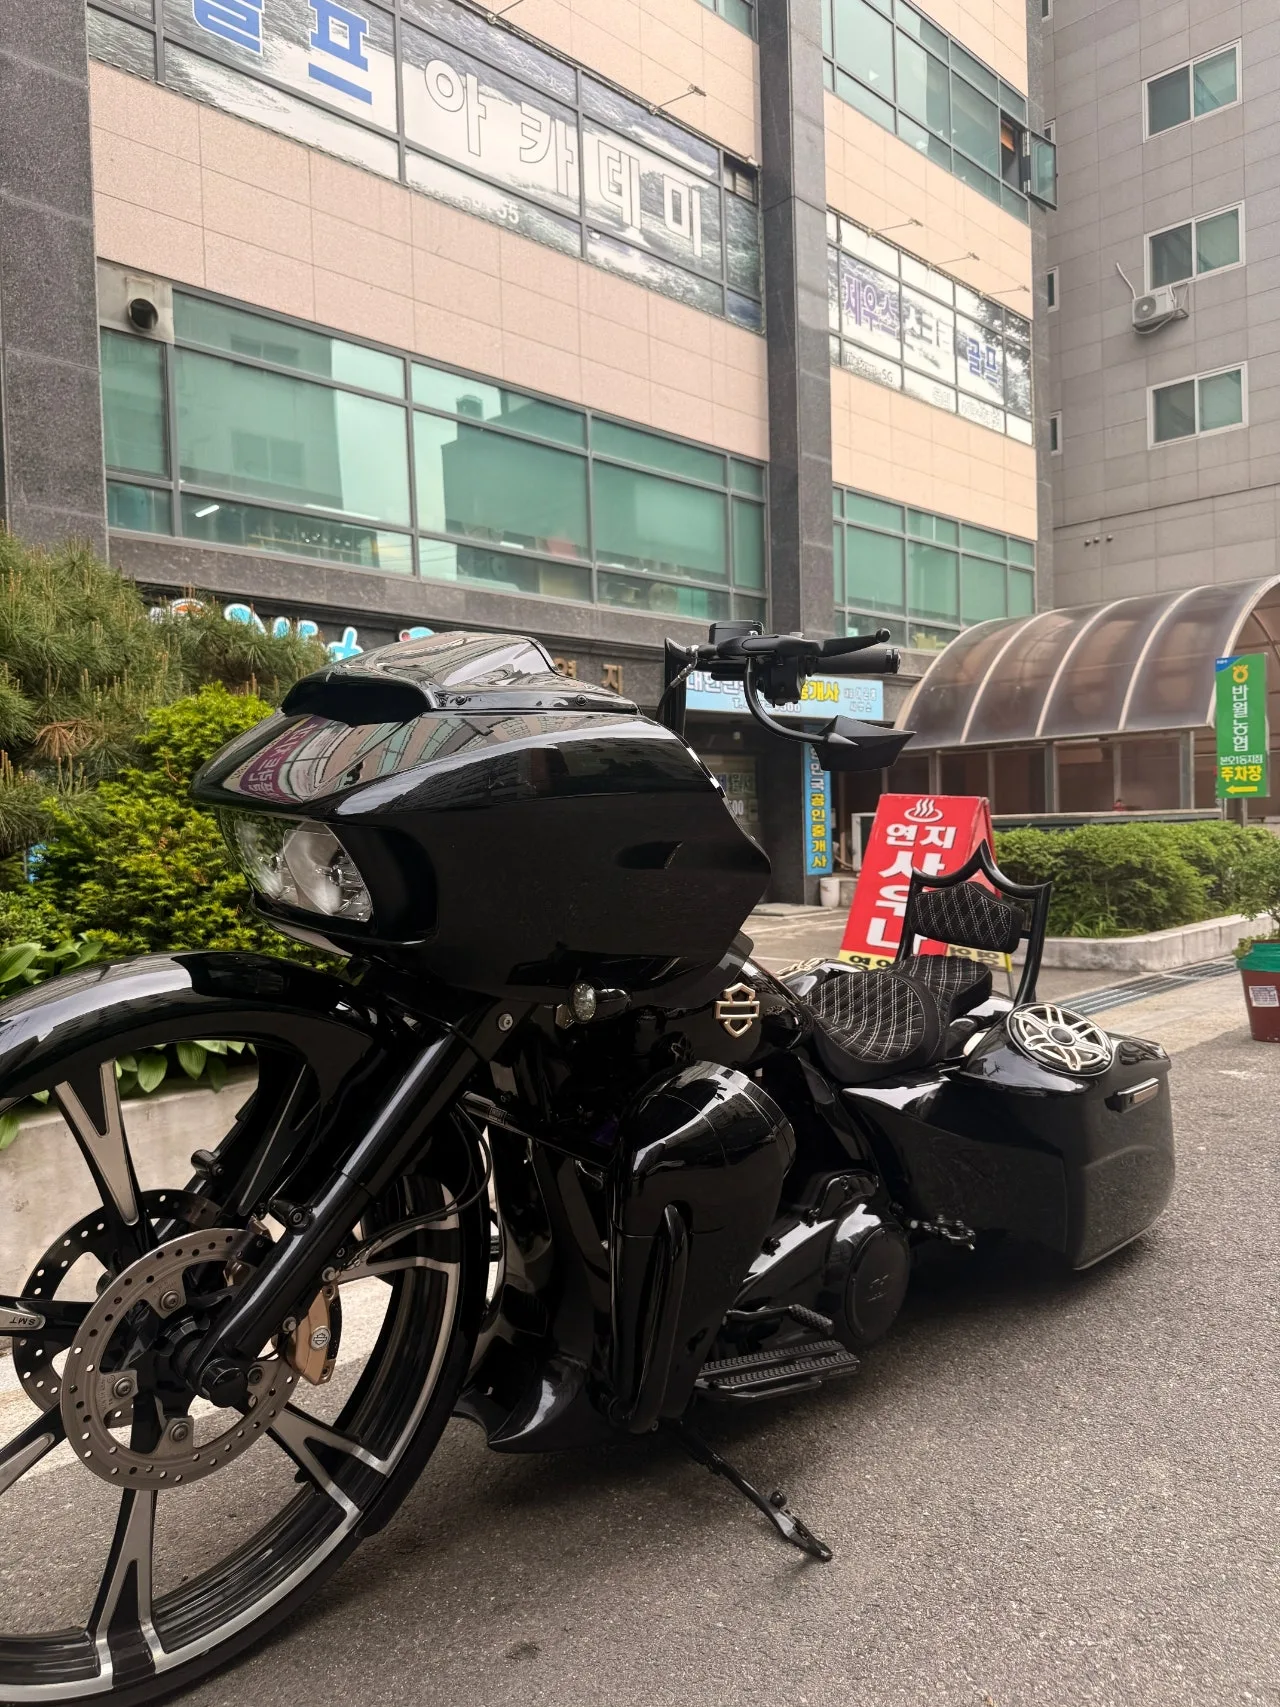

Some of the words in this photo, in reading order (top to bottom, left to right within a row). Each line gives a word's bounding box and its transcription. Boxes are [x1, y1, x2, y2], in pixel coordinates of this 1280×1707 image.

[424, 59, 702, 258] 아카데미
[1232, 684, 1249, 752] 반월농협
[1221, 765, 1262, 783] 주차장
[886, 823, 957, 849] 연지
[9, 1317, 36, 1326] SMT
